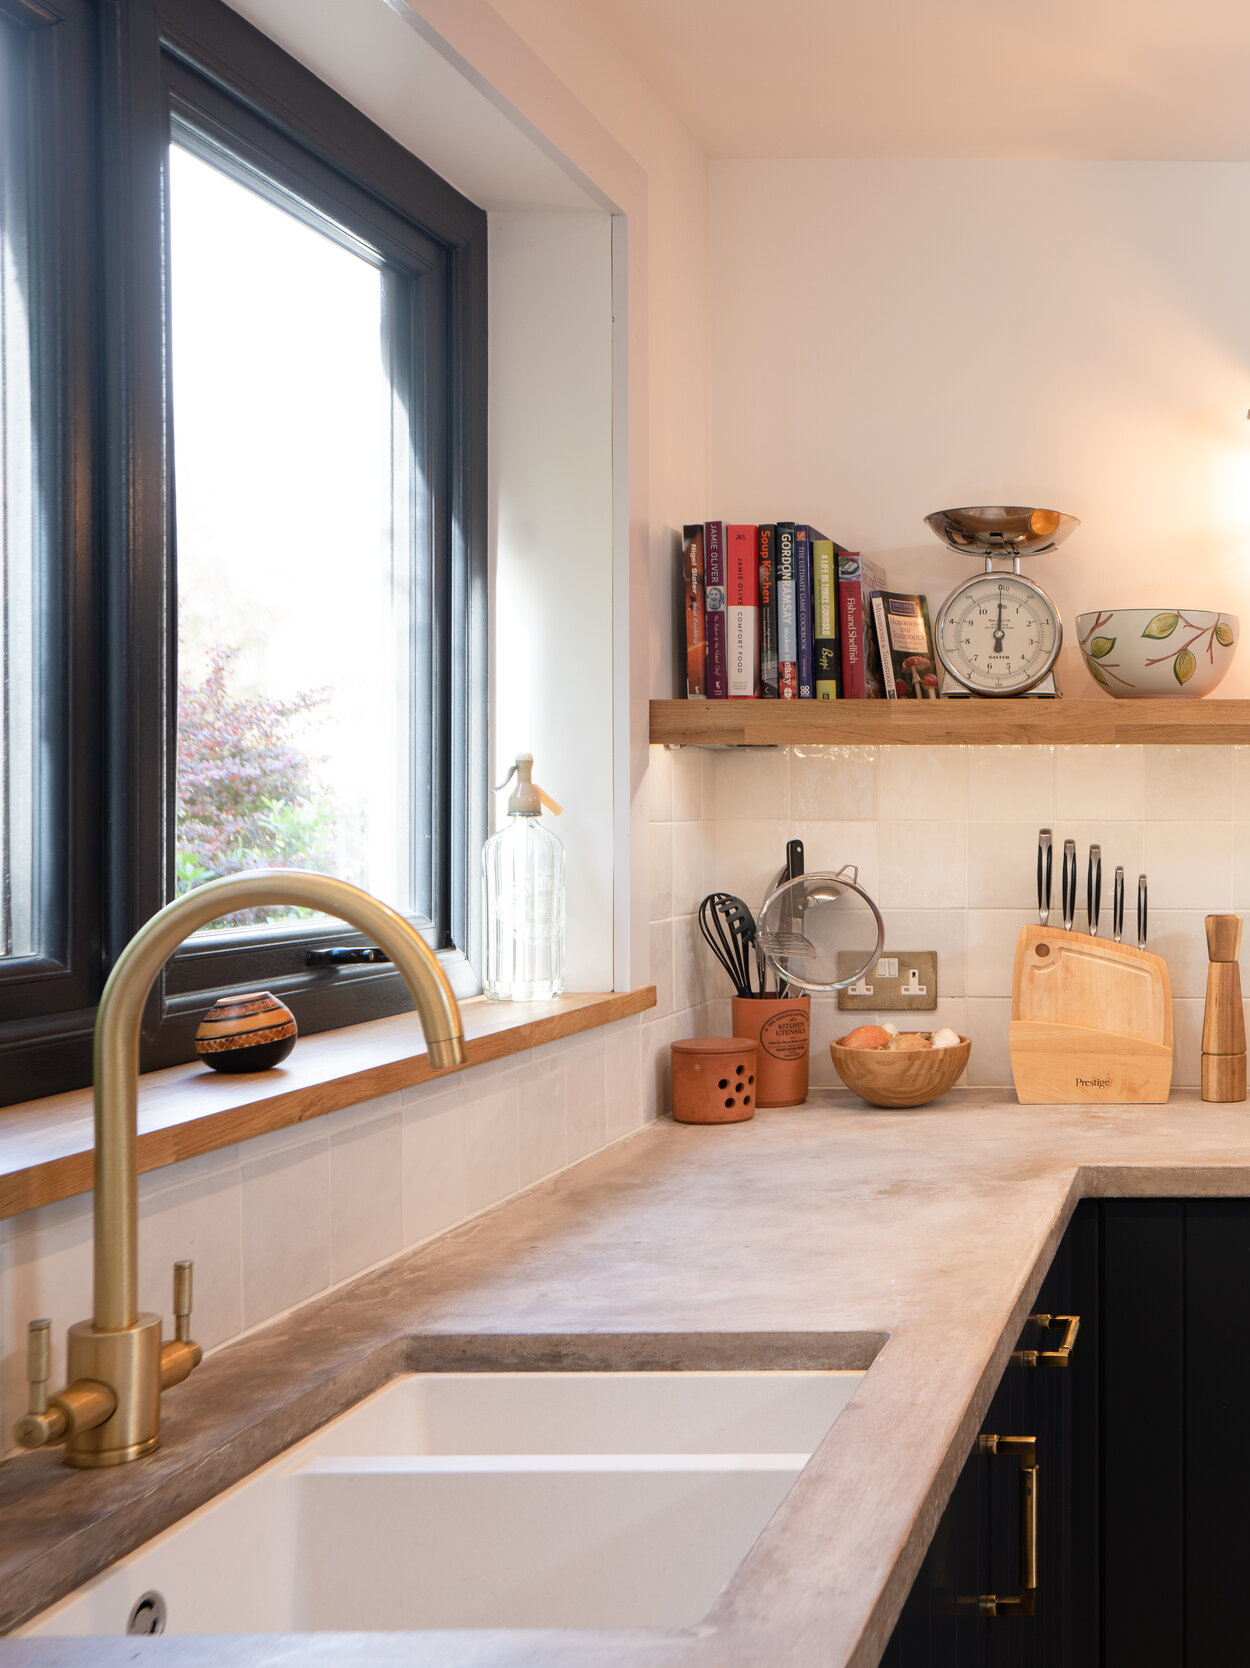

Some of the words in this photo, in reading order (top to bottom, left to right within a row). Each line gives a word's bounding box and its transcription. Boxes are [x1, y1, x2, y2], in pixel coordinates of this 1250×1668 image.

[710, 524, 718, 550] JAMIE
[760, 530, 771, 559] Soup
[711, 552, 719, 583] OLIVER
[781, 533, 792, 580] GORDON
[821, 560, 829, 574] LIFE
[762, 560, 772, 604] Kitchen
[821, 574, 829, 583] IN
[782, 580, 792, 625] RAMSAY
[822, 583, 830, 604] THREE
[847, 598, 857, 614] Fish
[822, 604, 831, 636] COURSES
[847, 614, 857, 630] and
[889, 616, 921, 626] MUSHROOM
[848, 630, 858, 664] Shellfish
[782, 661, 792, 685] easy
[775, 1028, 806, 1036] UTENSILS
[778, 1022, 805, 1030] KITCHEN
[1075, 1078, 1110, 1089] Prestige
